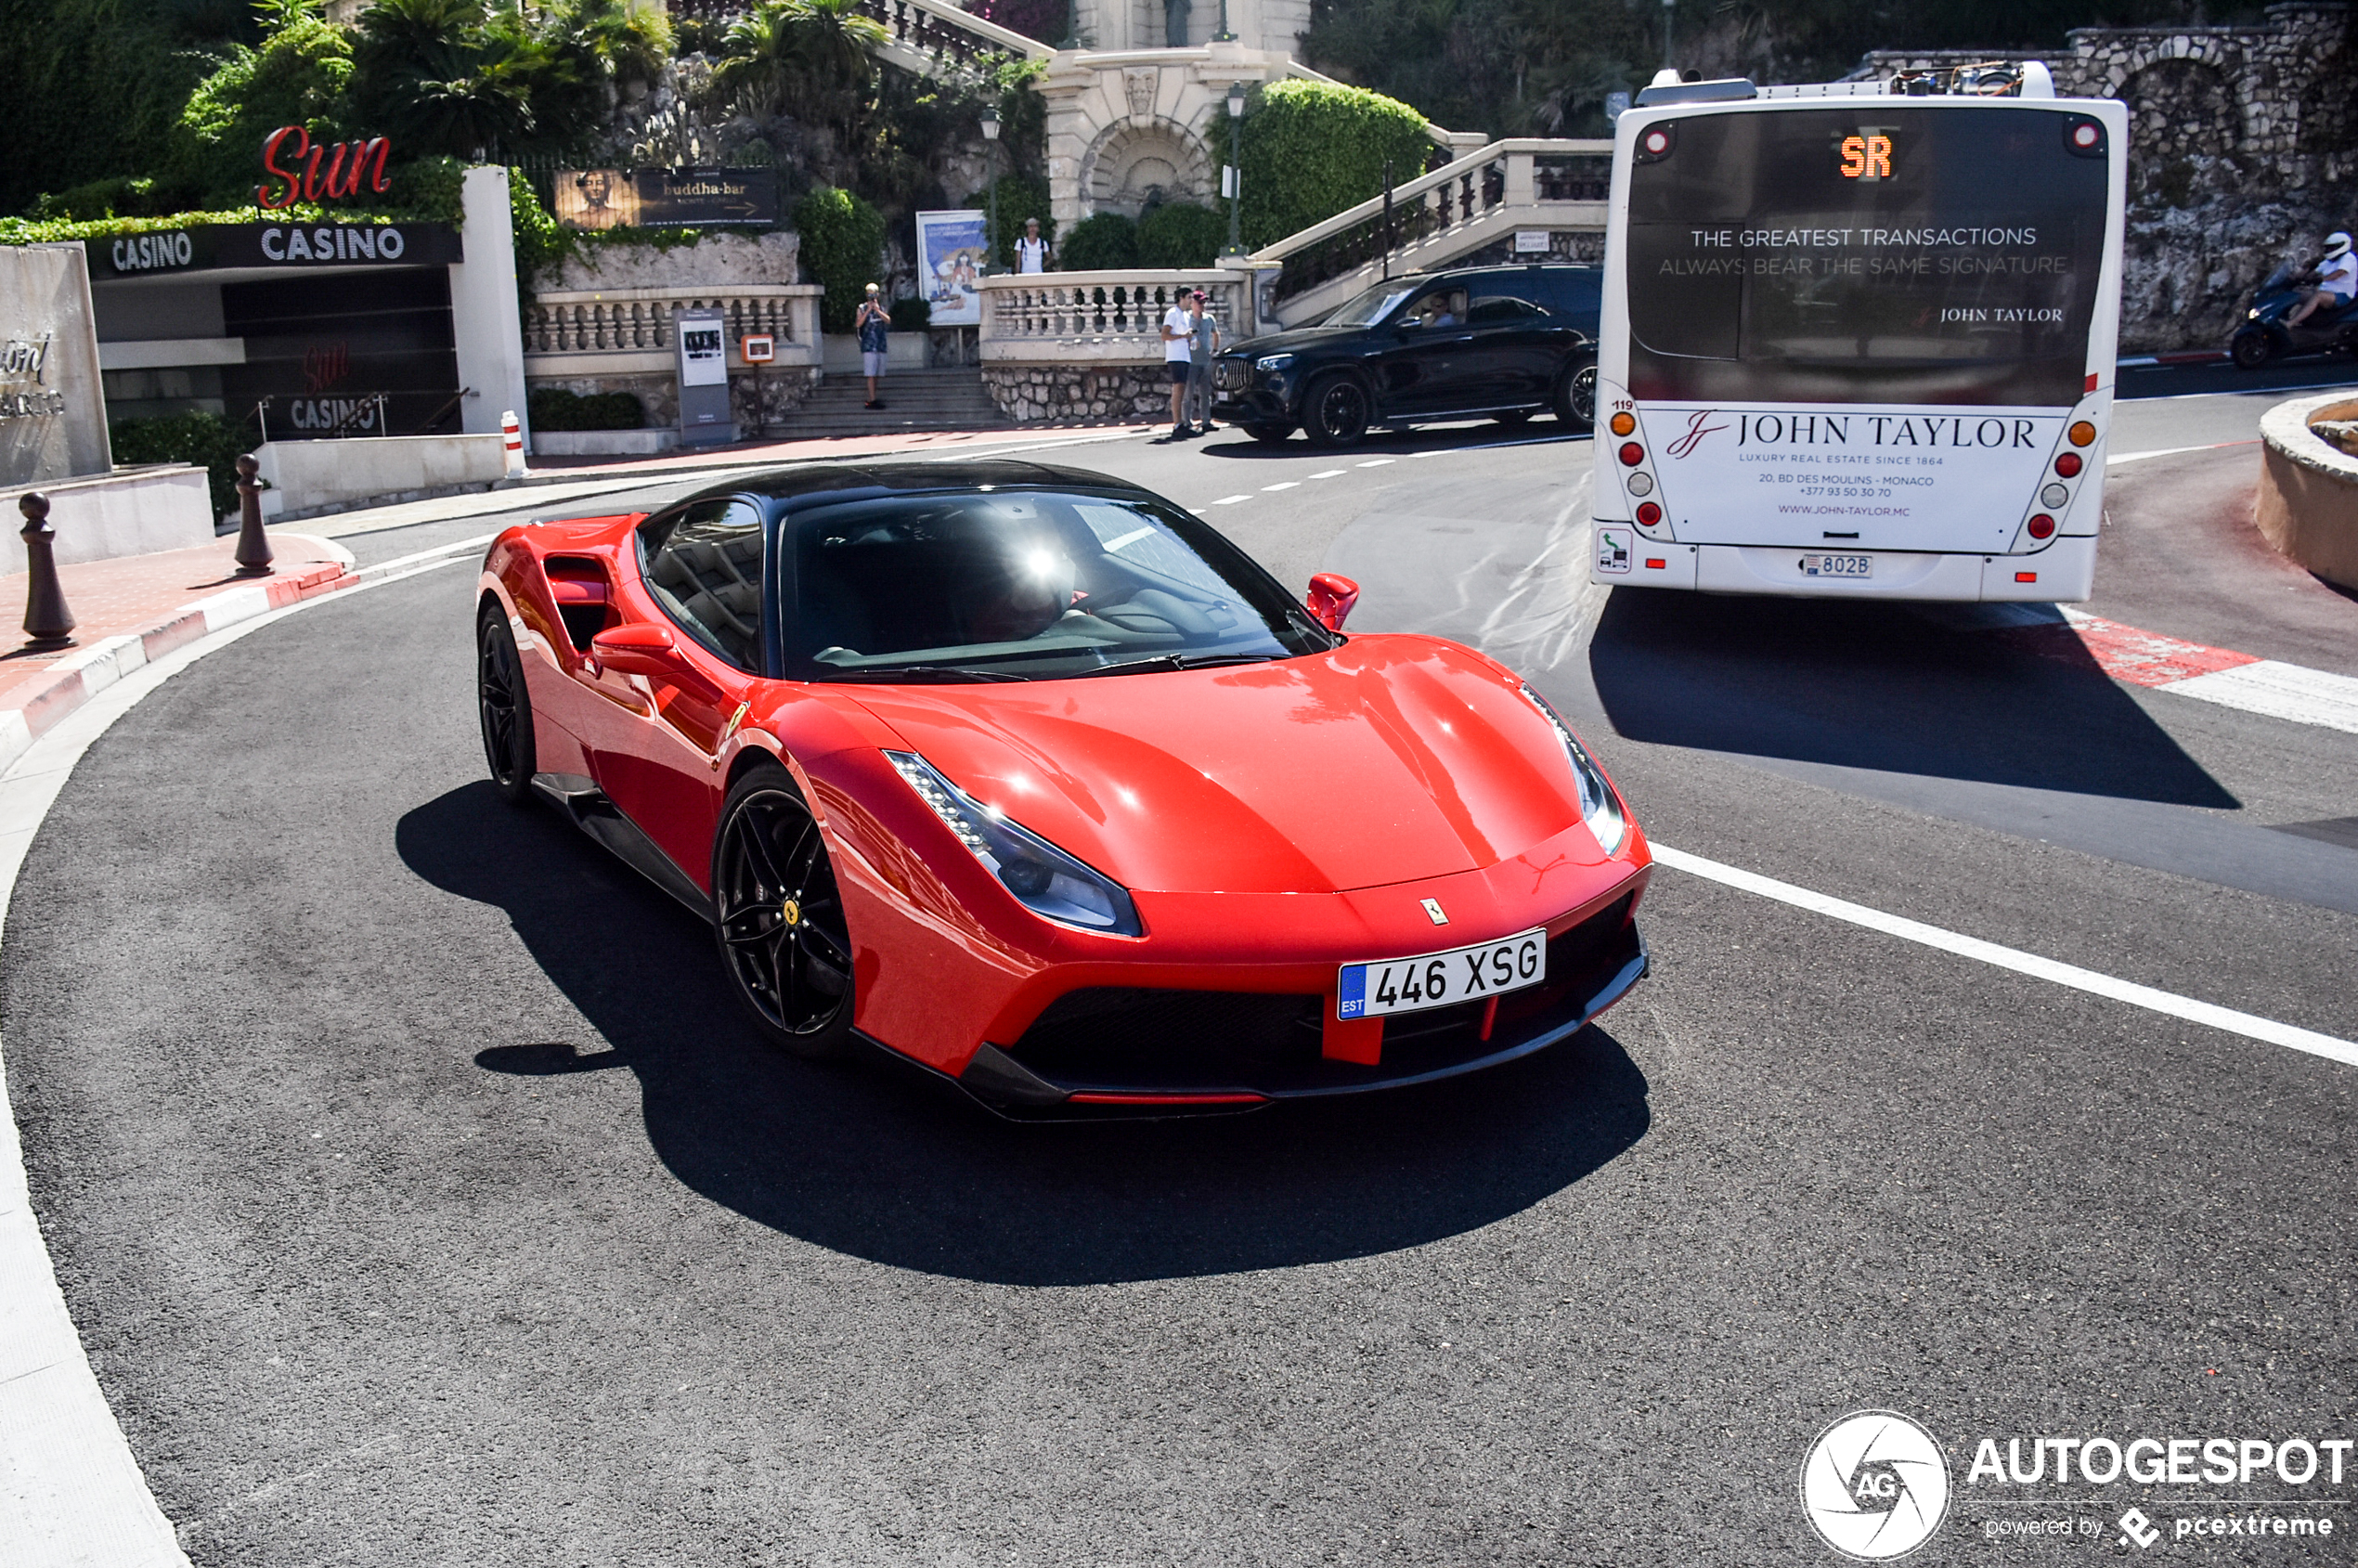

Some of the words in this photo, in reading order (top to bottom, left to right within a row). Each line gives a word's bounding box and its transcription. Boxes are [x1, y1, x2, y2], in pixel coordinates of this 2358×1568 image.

[1840, 136, 1891, 177] SR
[253, 124, 391, 209] Sun
[664, 182, 745, 196] buddha-bar
[261, 228, 404, 261] CASINO
[1691, 230, 1731, 247] THE
[1739, 229, 1852, 247] GREATEST
[1860, 227, 2036, 245] TRANSACTIONS
[112, 233, 192, 271] CASINO
[1659, 258, 1746, 275] ALWAYS
[1754, 258, 1813, 275] BEAR
[1821, 258, 1861, 274] THE
[1871, 257, 1930, 274] SAME
[1939, 257, 2066, 274] SIGNATURE
[1941, 309, 1987, 322] JOHN
[1994, 308, 2063, 322] TAYLOR
[1613, 400, 1633, 410] 119
[291, 399, 374, 429] CASINO
[1738, 415, 1848, 447] JOHN
[1868, 417, 2036, 448] TAYLOR
[1740, 453, 1785, 462] LUXURY
[1792, 455, 1820, 463] REAL
[1827, 455, 1870, 464] ESTATE
[1876, 456, 1911, 465] SINCE
[1916, 457, 1943, 465] 1864
[1759, 473, 1775, 484] 20,
[1779, 474, 1794, 484] BD
[1797, 474, 1819, 484] DES
[1821, 475, 1872, 485] MOULINS
[1883, 476, 1934, 486] MONACO
[1800, 487, 1824, 496] +377
[1827, 487, 1840, 496] 93
[1844, 487, 1858, 497] 50
[1860, 488, 1874, 497] 30
[1877, 488, 1891, 497] 70
[1779, 505, 1910, 516] WWW.JOHN-TAYLOR.MC
[1823, 557, 1869, 573] 802B
[1376, 961, 1445, 1006] 446
[1464, 940, 1537, 994] XSG
[1341, 1000, 1364, 1013] EST
